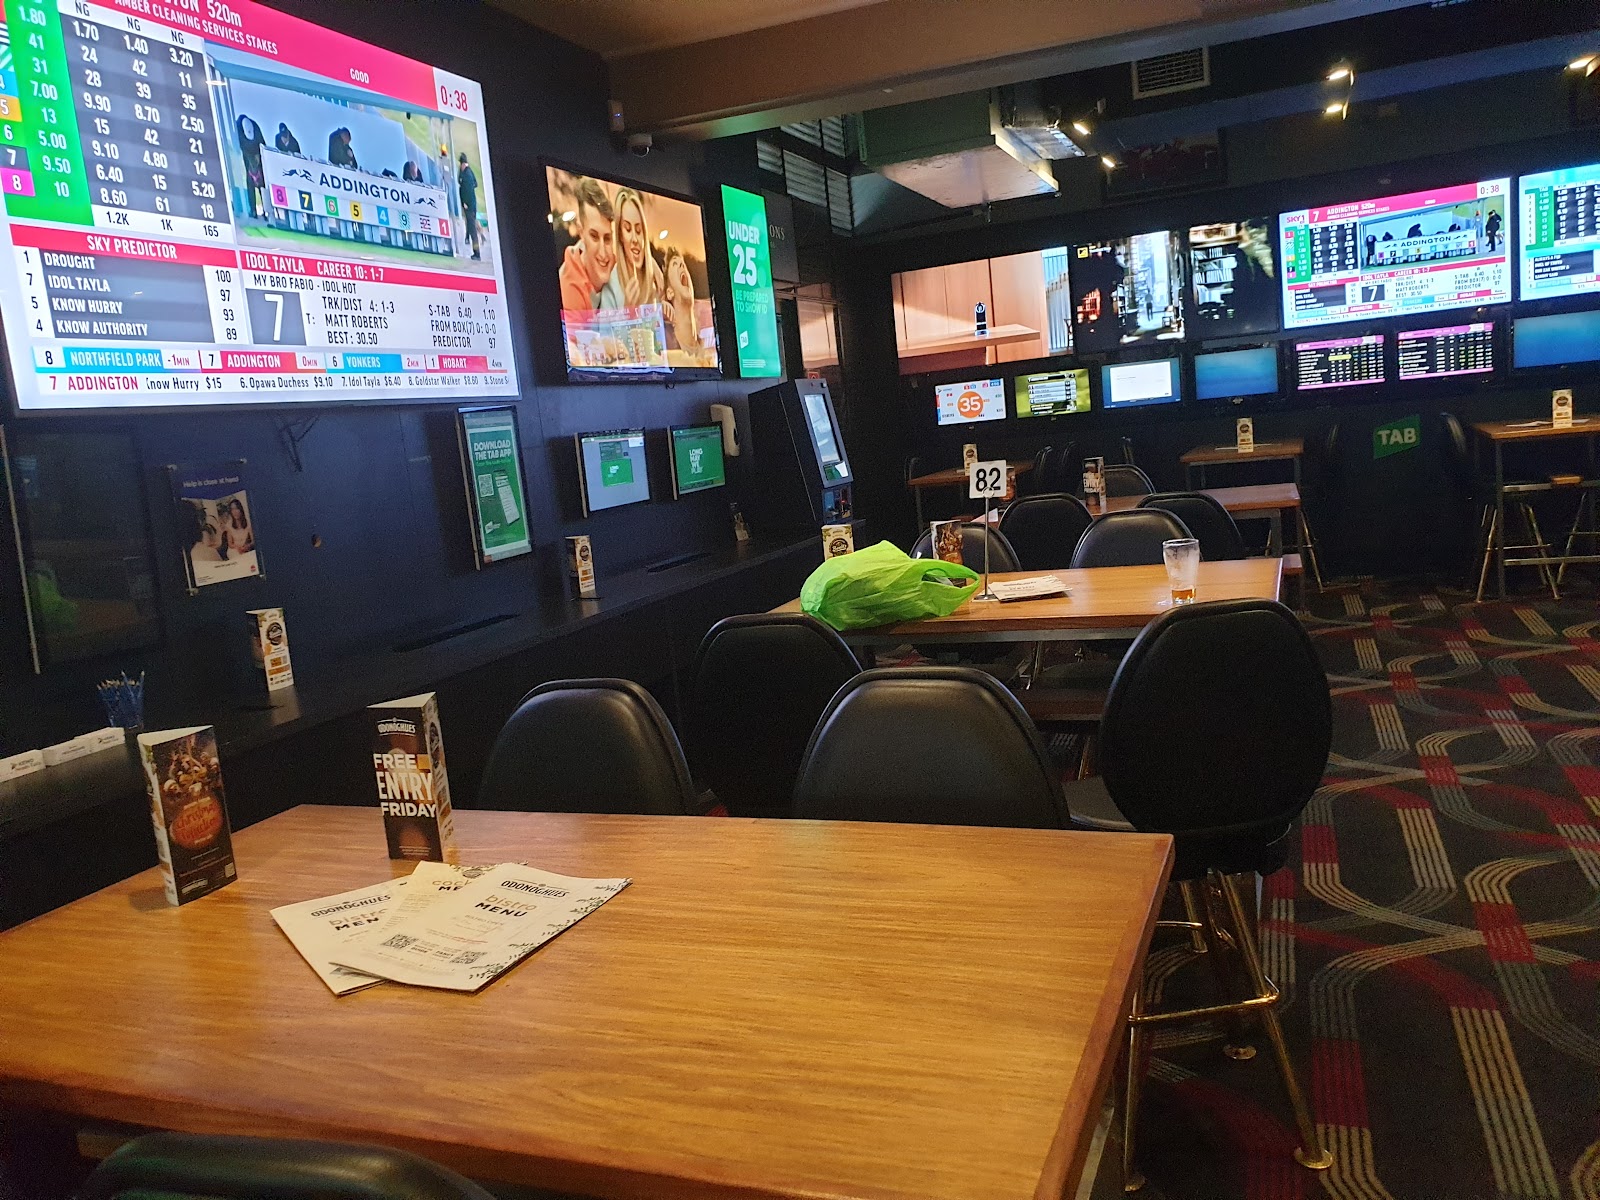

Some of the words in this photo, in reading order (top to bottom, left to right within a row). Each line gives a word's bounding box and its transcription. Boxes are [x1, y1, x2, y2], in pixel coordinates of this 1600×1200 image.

[75, 1, 90, 16] NG
[127, 16, 141, 31] NG
[171, 30, 185, 45] NG
[206, 0, 242, 27] 520m
[18, 5, 46, 26] 1.80
[72, 20, 99, 41] 1.70
[123, 35, 149, 55] 1.40
[169, 47, 194, 68] 3.20
[152, 3, 201, 31] CLEANING
[201, 20, 245, 45] SERVICES
[246, 35, 278, 55] STAKES
[29, 33, 44, 50] 41
[81, 46, 98, 64] 24
[133, 59, 148, 77] 42
[179, 72, 193, 89] 11
[33, 57, 48, 75] 31
[85, 69, 102, 87] 28
[136, 82, 151, 100] 39
[181, 93, 197, 111] 35
[350, 67, 370, 84] GOOD
[30, 80, 58, 101] 7.00
[83, 93, 111, 113] 9.90
[135, 105, 160, 124] 8.70
[181, 115, 205, 134] 2.50
[440, 84, 468, 112] 0:38
[41, 107, 57, 124] 13
[94, 118, 110, 135] 15
[144, 129, 160, 146] 42
[189, 138, 204, 155] 21
[4, 124, 13, 141] 6
[38, 130, 67, 150] 5.00
[92, 140, 119, 160] 9.10
[143, 150, 168, 169] 4.80
[193, 160, 208, 176] 14
[6, 148, 17, 166] 7
[42, 155, 71, 175] 9.50
[96, 164, 123, 183] 6.40
[152, 174, 167, 190] 15
[192, 180, 216, 198] 5.20
[12, 174, 22, 191] 8
[54, 181, 70, 198] 10
[101, 187, 128, 207] 8.60
[155, 197, 170, 213] 61
[201, 202, 215, 219] 18
[319, 173, 411, 205] ADDINGTON
[1480, 184, 1500, 195] 0:38
[302, 194, 310, 208] 7
[353, 204, 360, 218] 5
[379, 209, 387, 223] 4
[1312, 210, 1320, 222] 7
[1327, 204, 1359, 216] ADDINGTON
[106, 211, 129, 226] 1.2K
[160, 218, 174, 232] 1K
[203, 223, 219, 238] 165
[728, 220, 760, 245] UNDER
[87, 235, 111, 252] SKY
[114, 239, 177, 259] PREDICTOR
[1401, 236, 1451, 247] ADDINGTON
[23, 250, 29, 263] 1
[43, 252, 96, 270] DROUGHT
[215, 269, 232, 283] 100
[245, 253, 271, 270] IDOL
[272, 256, 306, 274] TAYLA
[317, 261, 352, 278] CAREER
[354, 265, 368, 280] 10:
[371, 267, 384, 281] 1-7
[733, 244, 757, 287] 25
[26, 272, 33, 286] 7
[47, 274, 75, 290] IDOL
[75, 277, 111, 292] TAYLA
[220, 289, 231, 302] 97
[253, 273, 267, 287] MY
[270, 275, 287, 288] BRO
[290, 277, 314, 291] FABIO
[322, 280, 341, 293] IDOL
[343, 282, 357, 294] HOT
[1367, 285, 1378, 302] 7
[322, 296, 362, 311] TRK/DIST
[381, 300, 395, 314] 1-3
[735, 289, 743, 300] BE
[743, 290, 769, 304] PREPARED
[31, 296, 39, 309] 5
[52, 297, 86, 312] KNOW
[88, 300, 123, 315] HURRY
[223, 309, 234, 321] 93
[264, 293, 284, 341] 7
[428, 304, 451, 317] S-TAB
[458, 306, 472, 318] 6.40
[737, 301, 744, 312] TO
[745, 301, 760, 314] SHOW
[761, 303, 768, 314] ID
[36, 318, 43, 332] 4
[56, 319, 90, 334] KNOW
[93, 321, 148, 337] AUTHORITY
[226, 328, 237, 341] 89
[325, 313, 349, 327] MATT
[351, 315, 389, 329] ROBERTS
[430, 320, 452, 332] FROM
[356, 331, 378, 345] 30.50
[432, 335, 472, 348] PREDICTOR
[488, 338, 496, 349] 97
[45, 351, 54, 365] 8
[70, 351, 134, 367] NORTHFIELD
[136, 352, 162, 367] PARK
[208, 353, 215, 366] 7
[227, 353, 281, 368] ADDINGTON
[332, 356, 338, 367] 6
[346, 356, 381, 368] YONKERS
[442, 358, 467, 369] HOBART
[49, 376, 57, 390] 7
[68, 375, 139, 391] ADDINGTON
[172, 376, 199, 391] Hurry
[206, 376, 222, 390] $15
[250, 377, 276, 390] Opawa
[277, 376, 309, 388] Duchess
[313, 376, 333, 388] $9.10
[348, 375, 361, 387] Idol
[363, 376, 381, 388] Tayla
[384, 375, 402, 387] $6.40
[415, 375, 439, 386] Goldstar
[441, 376, 461, 386] Walker
[959, 395, 981, 413] 35
[473, 439, 511, 452] DOWNLOAD
[1377, 427, 1417, 446] TAB
[475, 451, 487, 461] THE
[488, 450, 499, 460] TAB
[500, 448, 512, 458] APP
[974, 466, 1002, 492] 82
[373, 753, 417, 769] FREE
[375, 771, 433, 801] ENTRY
[380, 802, 437, 818] FRIDAY
[501, 880, 570, 898] ODONOGHUES
[310, 894, 391, 917] ODONOGHUES
[474, 902, 529, 917] MENU
[485, 894, 538, 911] bistro
